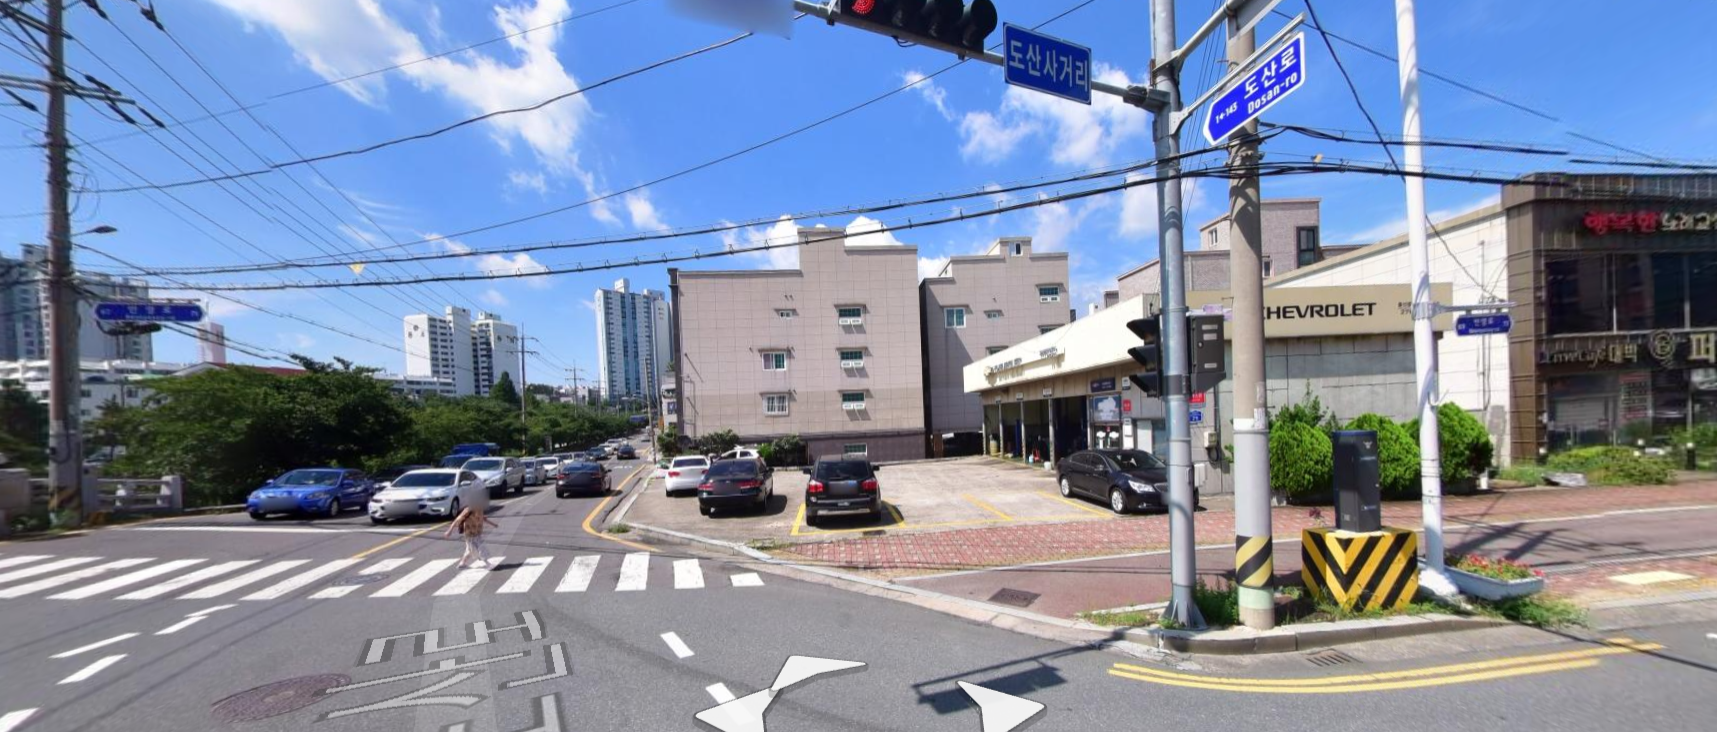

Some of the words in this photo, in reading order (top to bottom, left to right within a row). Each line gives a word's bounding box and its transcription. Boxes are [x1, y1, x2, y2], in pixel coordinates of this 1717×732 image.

[1009, 40, 1088, 92] 도산사거리
[1244, 46, 1297, 99] 도산로
[1247, 72, 1298, 114] Dosan-ro
[1584, 211, 1656, 236] 행복한
[1263, 302, 1377, 320] HEVROLET
